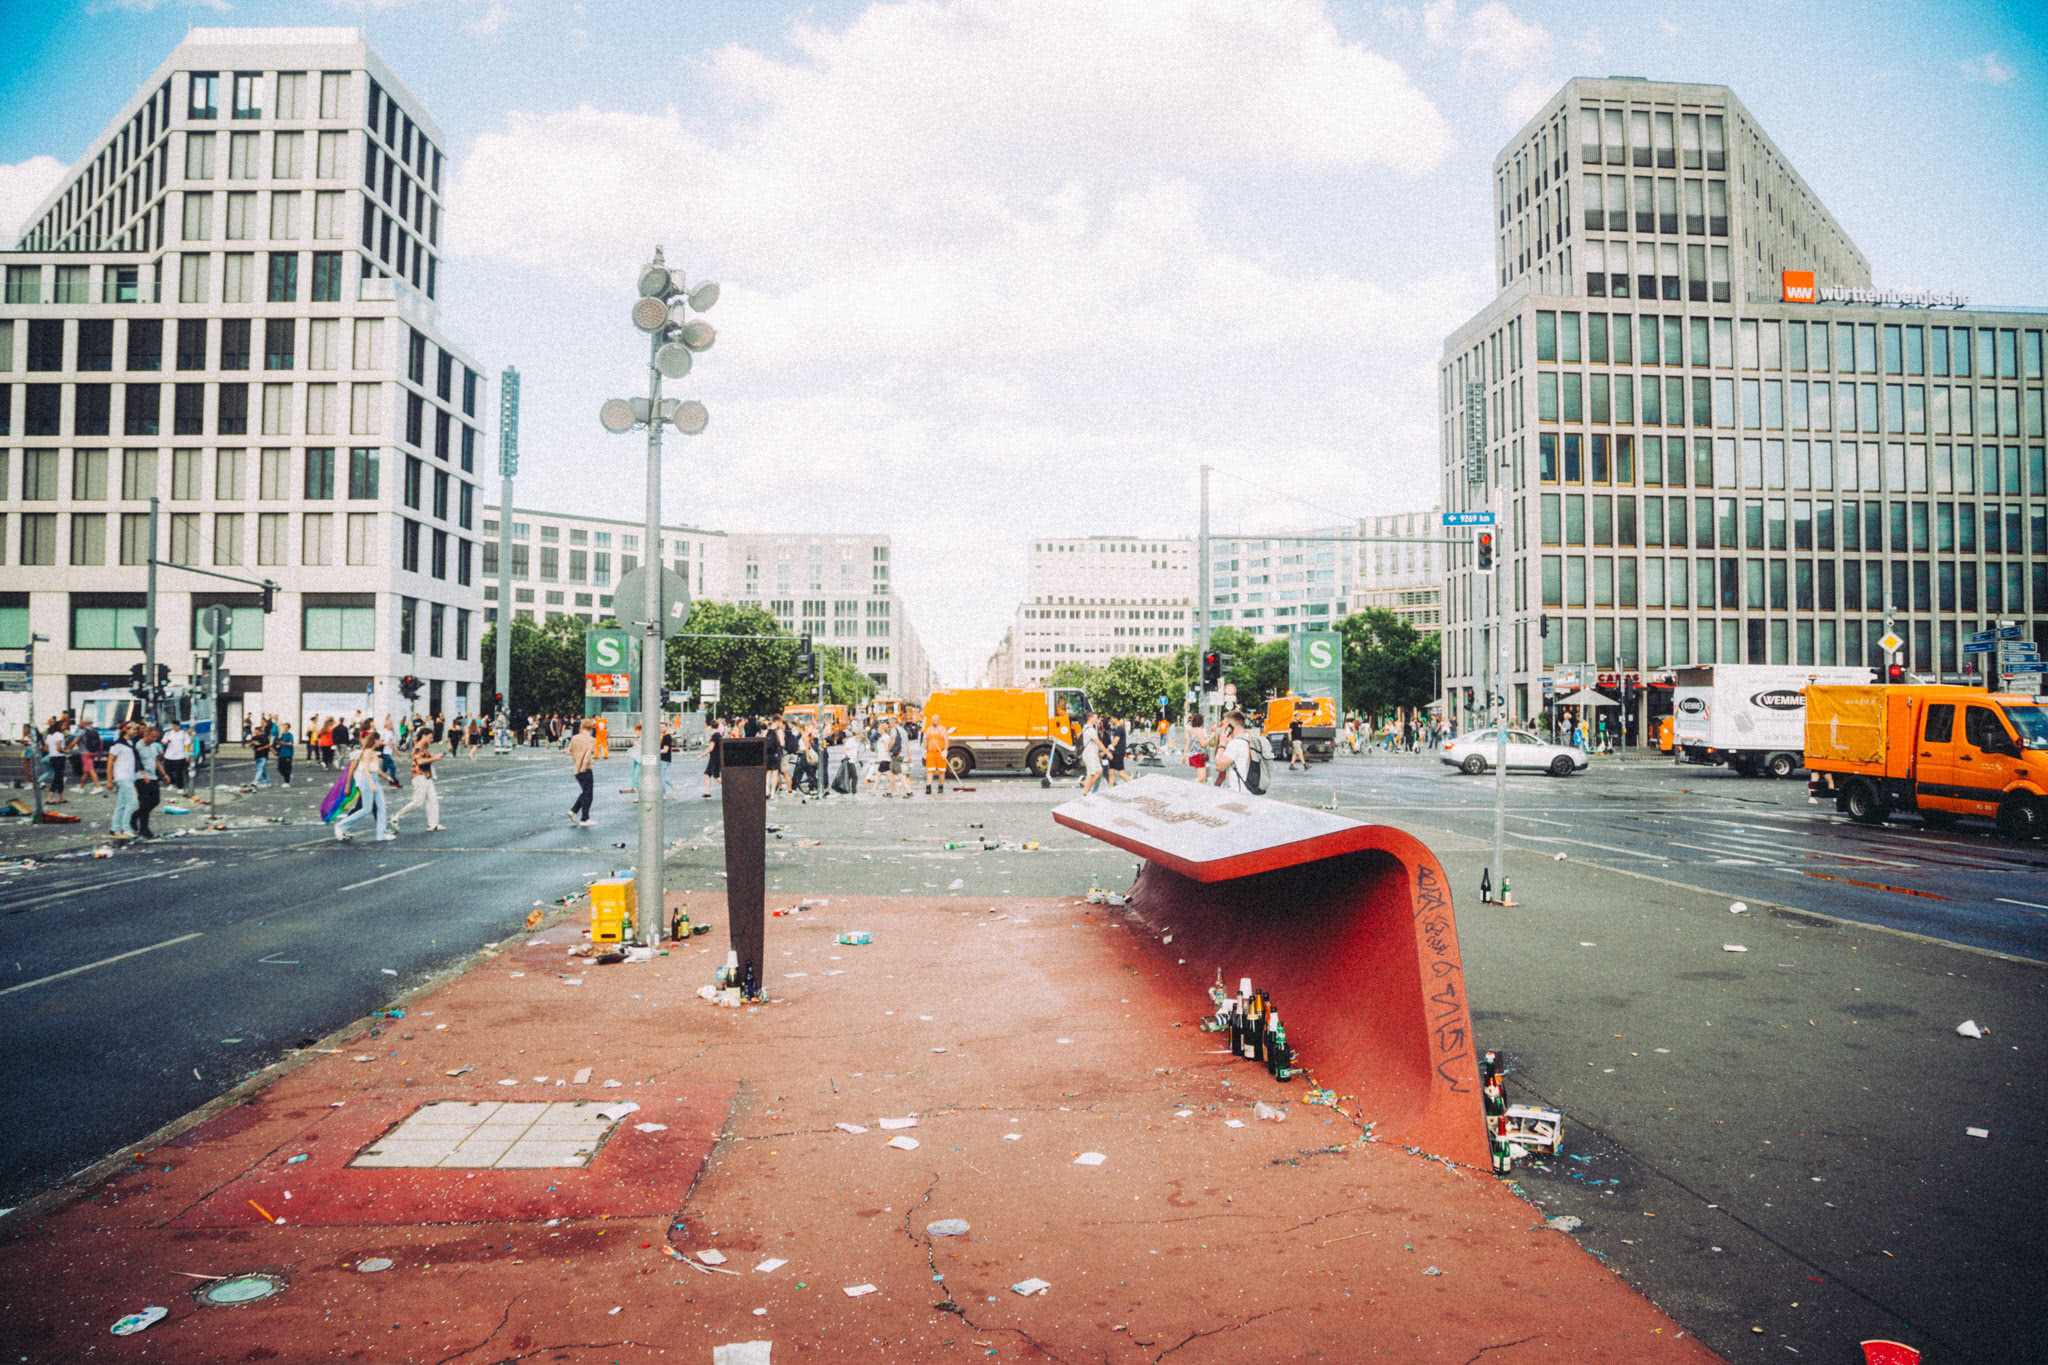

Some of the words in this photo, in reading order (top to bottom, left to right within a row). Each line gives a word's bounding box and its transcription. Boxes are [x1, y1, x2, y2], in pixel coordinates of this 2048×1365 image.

[1460, 514, 1478, 523] 9269
[1479, 514, 1490, 522] km
[597, 637, 620, 667] S
[1310, 640, 1332, 669] S
